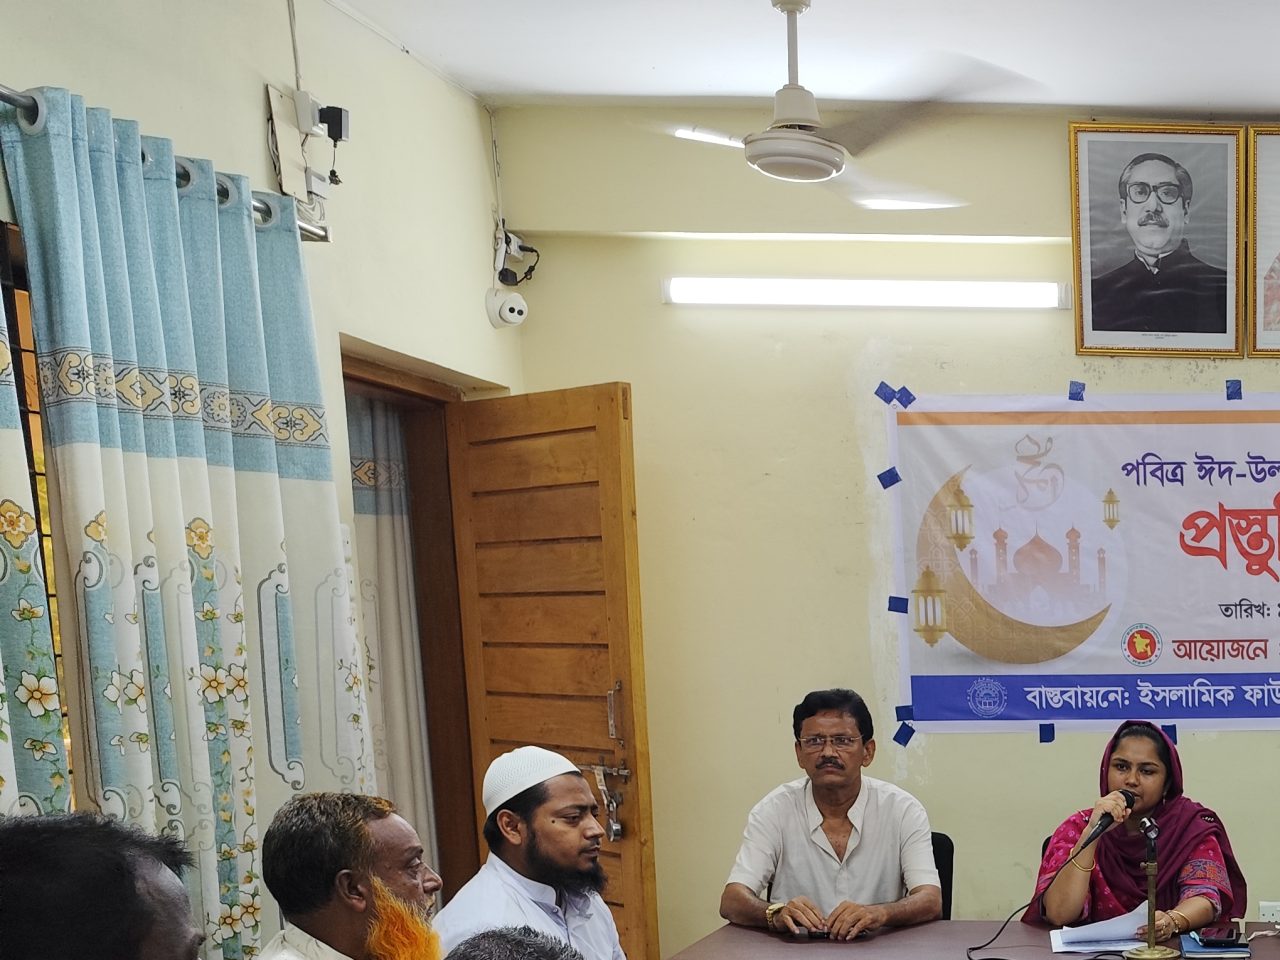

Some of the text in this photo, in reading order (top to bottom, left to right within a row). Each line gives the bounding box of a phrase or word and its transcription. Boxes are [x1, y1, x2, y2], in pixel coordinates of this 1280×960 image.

[1121, 452, 1188, 488] পবিত্র
[1218, 597, 1271, 620] তারিখ:
[1171, 638, 1269, 663] আয়োজনে
[1023, 685, 1130, 709] বাস্তবায়নে:
[1136, 678, 1236, 708] ইসলামিক
